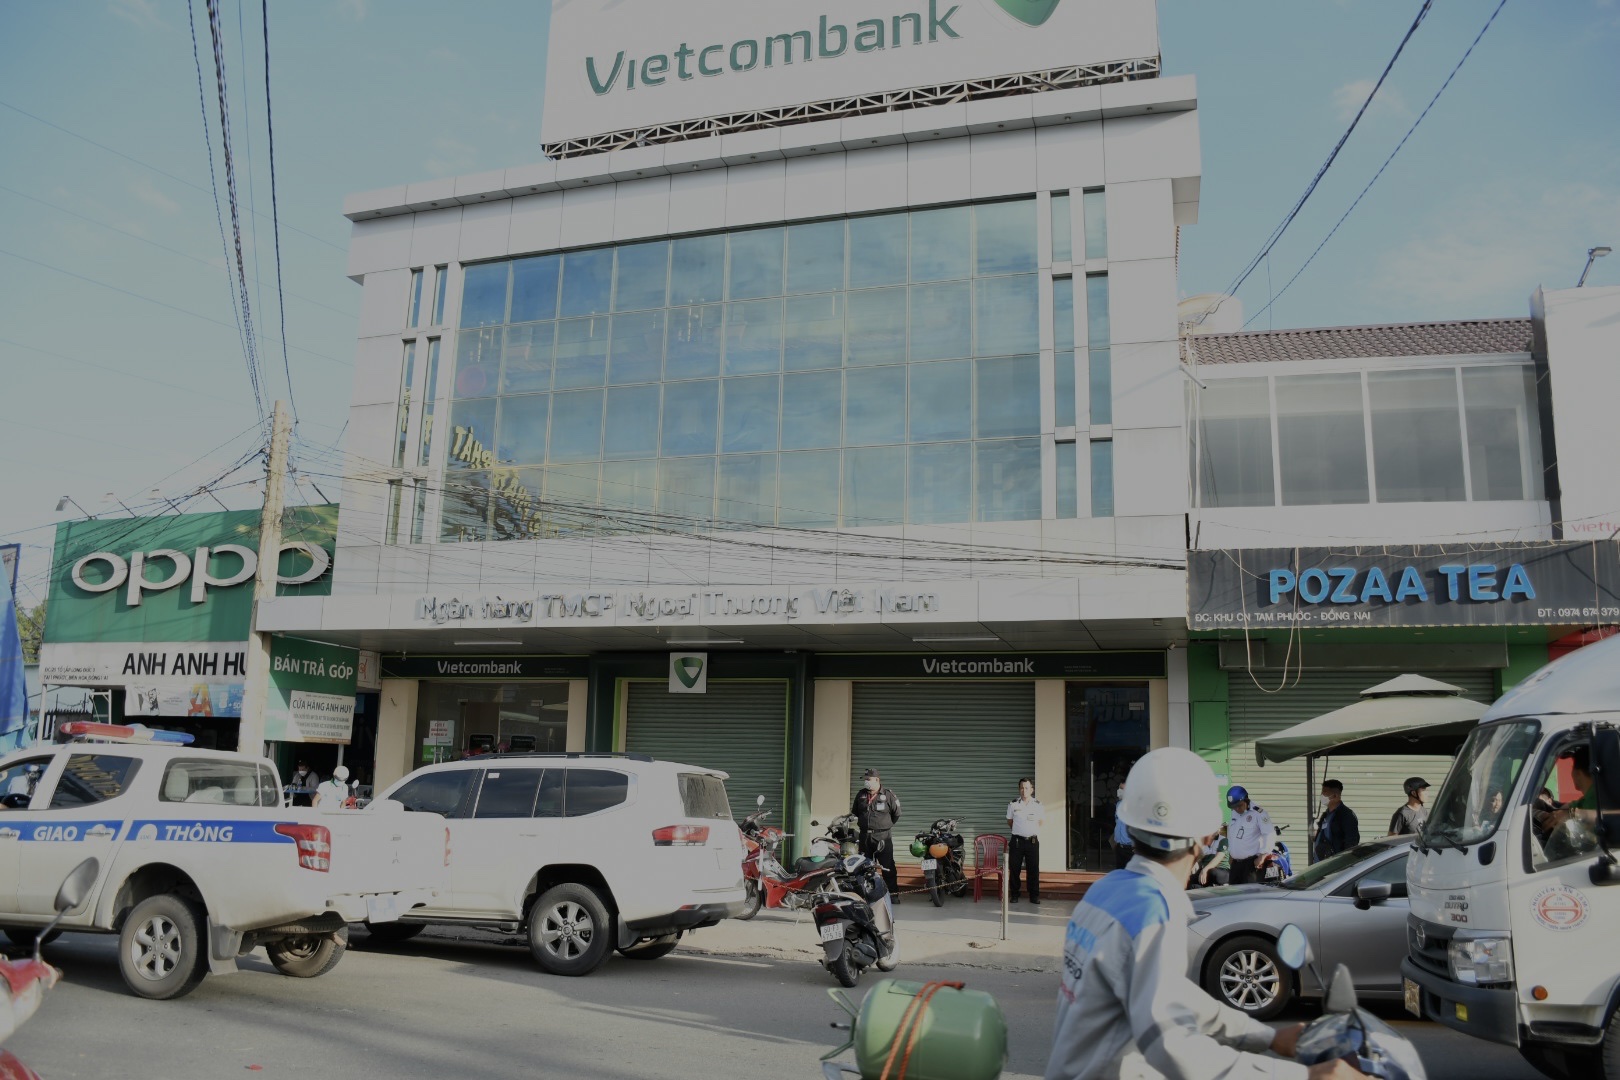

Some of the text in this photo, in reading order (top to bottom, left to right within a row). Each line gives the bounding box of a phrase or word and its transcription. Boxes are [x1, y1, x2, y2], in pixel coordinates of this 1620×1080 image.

[584, 0, 965, 96] Vietcombank
[1269, 563, 1537, 604] POZAA TEA
[421, 596, 474, 624] Ngân
[541, 593, 616, 619] TMCP
[875, 588, 941, 614] Nam
[1213, 612, 1234, 622] KHU
[1236, 612, 1251, 621] CN
[1254, 611, 1274, 621] TAM
[1353, 611, 1371, 621] NAI
[1558, 608, 1580, 617] 0974
[1601, 607, 1620, 616] 379
[122, 652, 165, 676] ANH
[172, 652, 218, 676] ANH
[274, 654, 354, 680] BÁN TRẢ GÓP
[437, 660, 522, 675] Vietcombank
[922, 658, 1035, 675] Vietcombank
[326, 702, 339, 712] ANH
[340, 704, 353, 714] HUY
[33, 820, 233, 842] GIAO THÔNG
